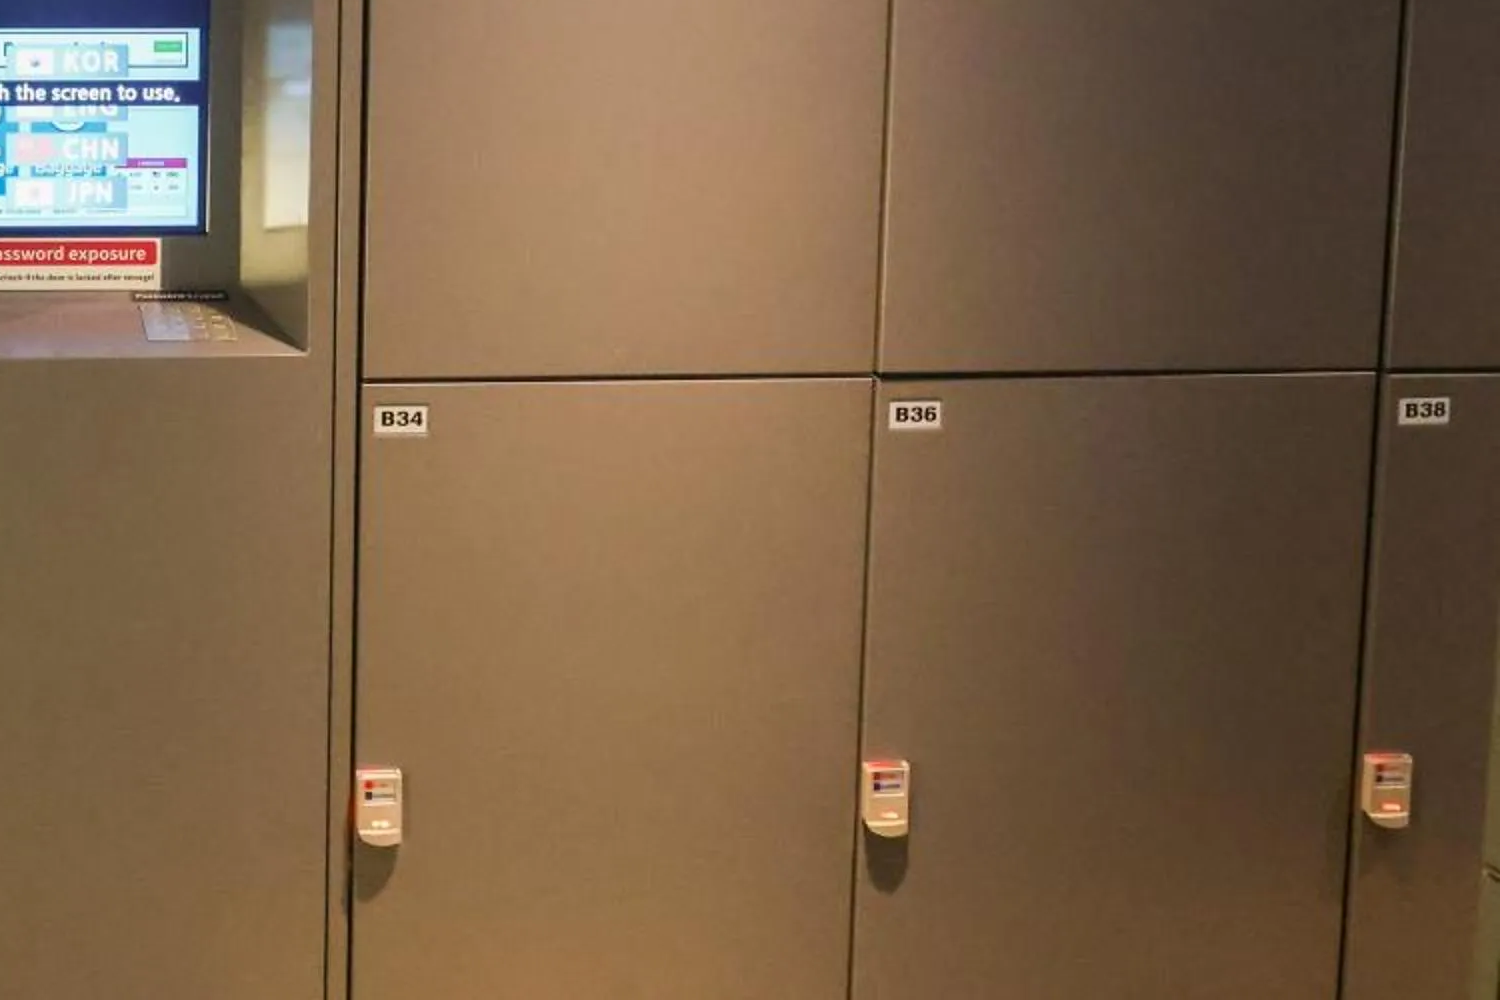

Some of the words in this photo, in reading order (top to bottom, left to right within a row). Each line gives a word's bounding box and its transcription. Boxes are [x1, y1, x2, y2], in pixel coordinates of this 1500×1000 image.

[64, 50, 119, 73] KOR
[15, 83, 47, 101] the
[51, 87, 111, 102] screen
[117, 84, 137, 101] to
[143, 87, 181, 102] use.
[63, 138, 119, 160] CHN
[68, 181, 113, 203] JPN
[68, 247, 147, 264] exposure
[895, 406, 937, 423] B36
[1405, 402, 1446, 418] B38
[381, 411, 422, 428] B34
